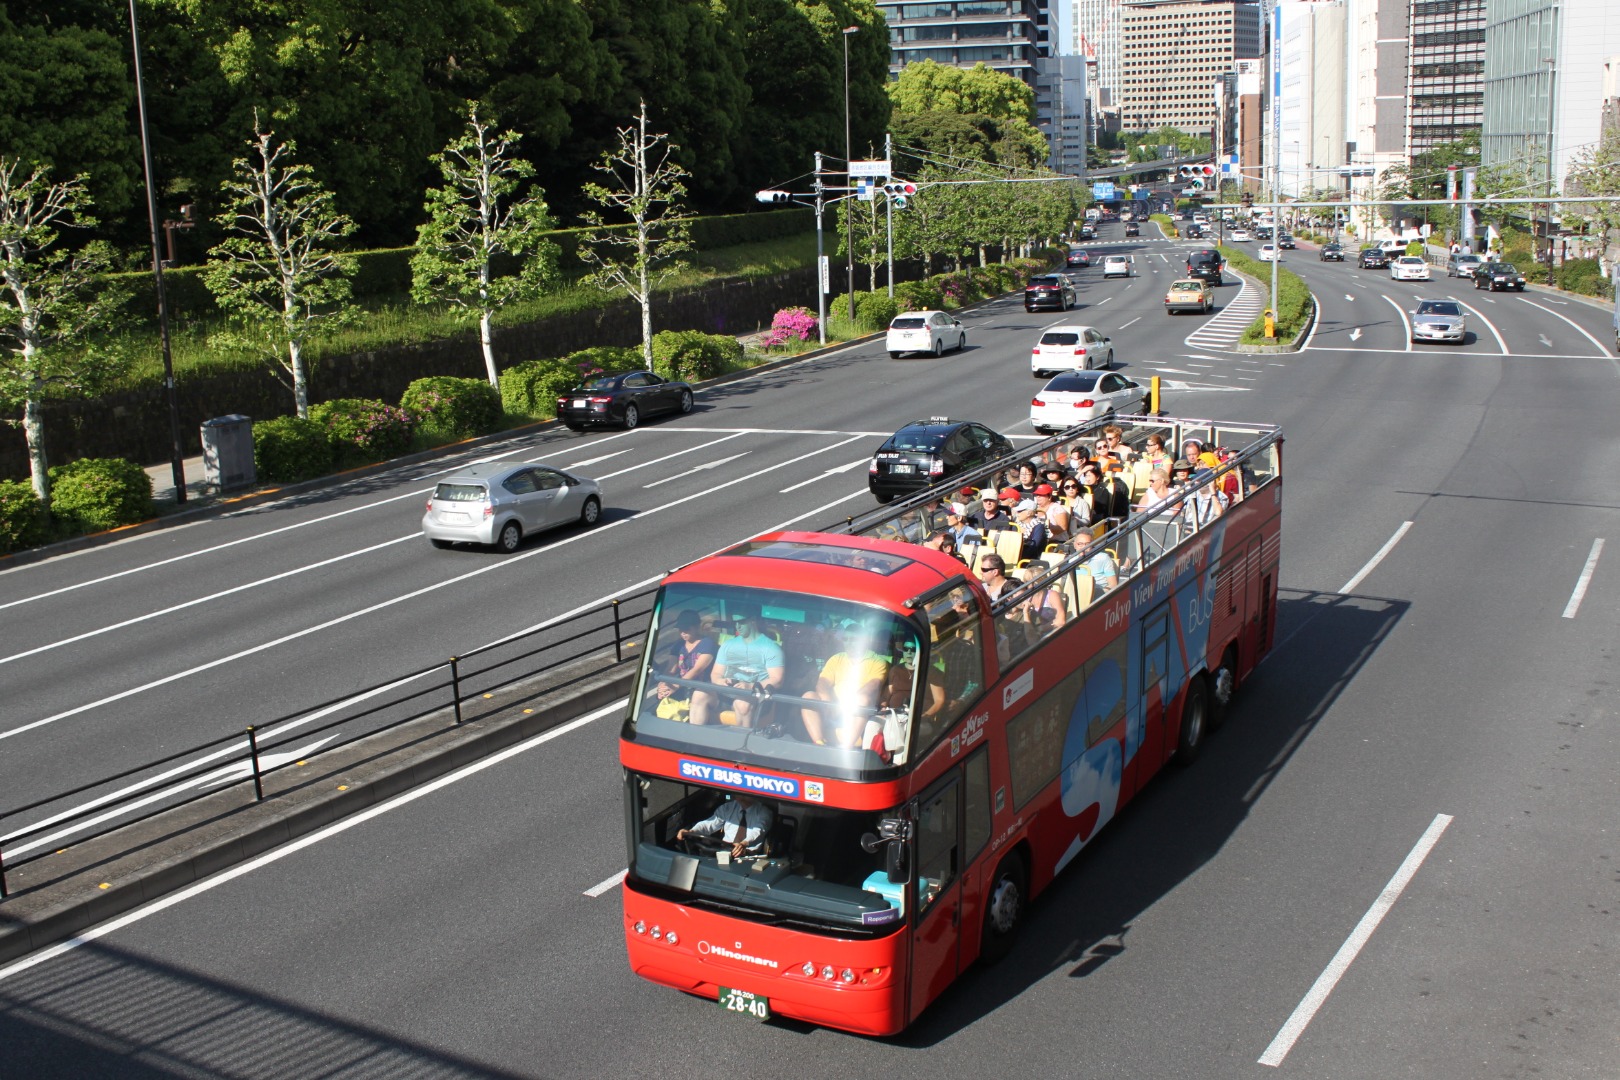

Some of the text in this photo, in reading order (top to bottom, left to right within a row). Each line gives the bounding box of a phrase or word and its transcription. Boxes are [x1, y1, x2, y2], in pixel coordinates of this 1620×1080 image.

[1104, 600, 1131, 631] Tokyo
[1134, 583, 1155, 608] View
[1157, 568, 1176, 592] from
[1178, 555, 1191, 576] the
[1188, 583, 1214, 634] BUS
[961, 715, 978, 745] SKY
[977, 711, 989, 728] BUS
[682, 762, 712, 779] SKY
[714, 770, 743, 785] BUS
[744, 775, 795, 794] TOKYO
[711, 945, 778, 968] Hinomaru
[726, 994, 766, 1018] 28-40
